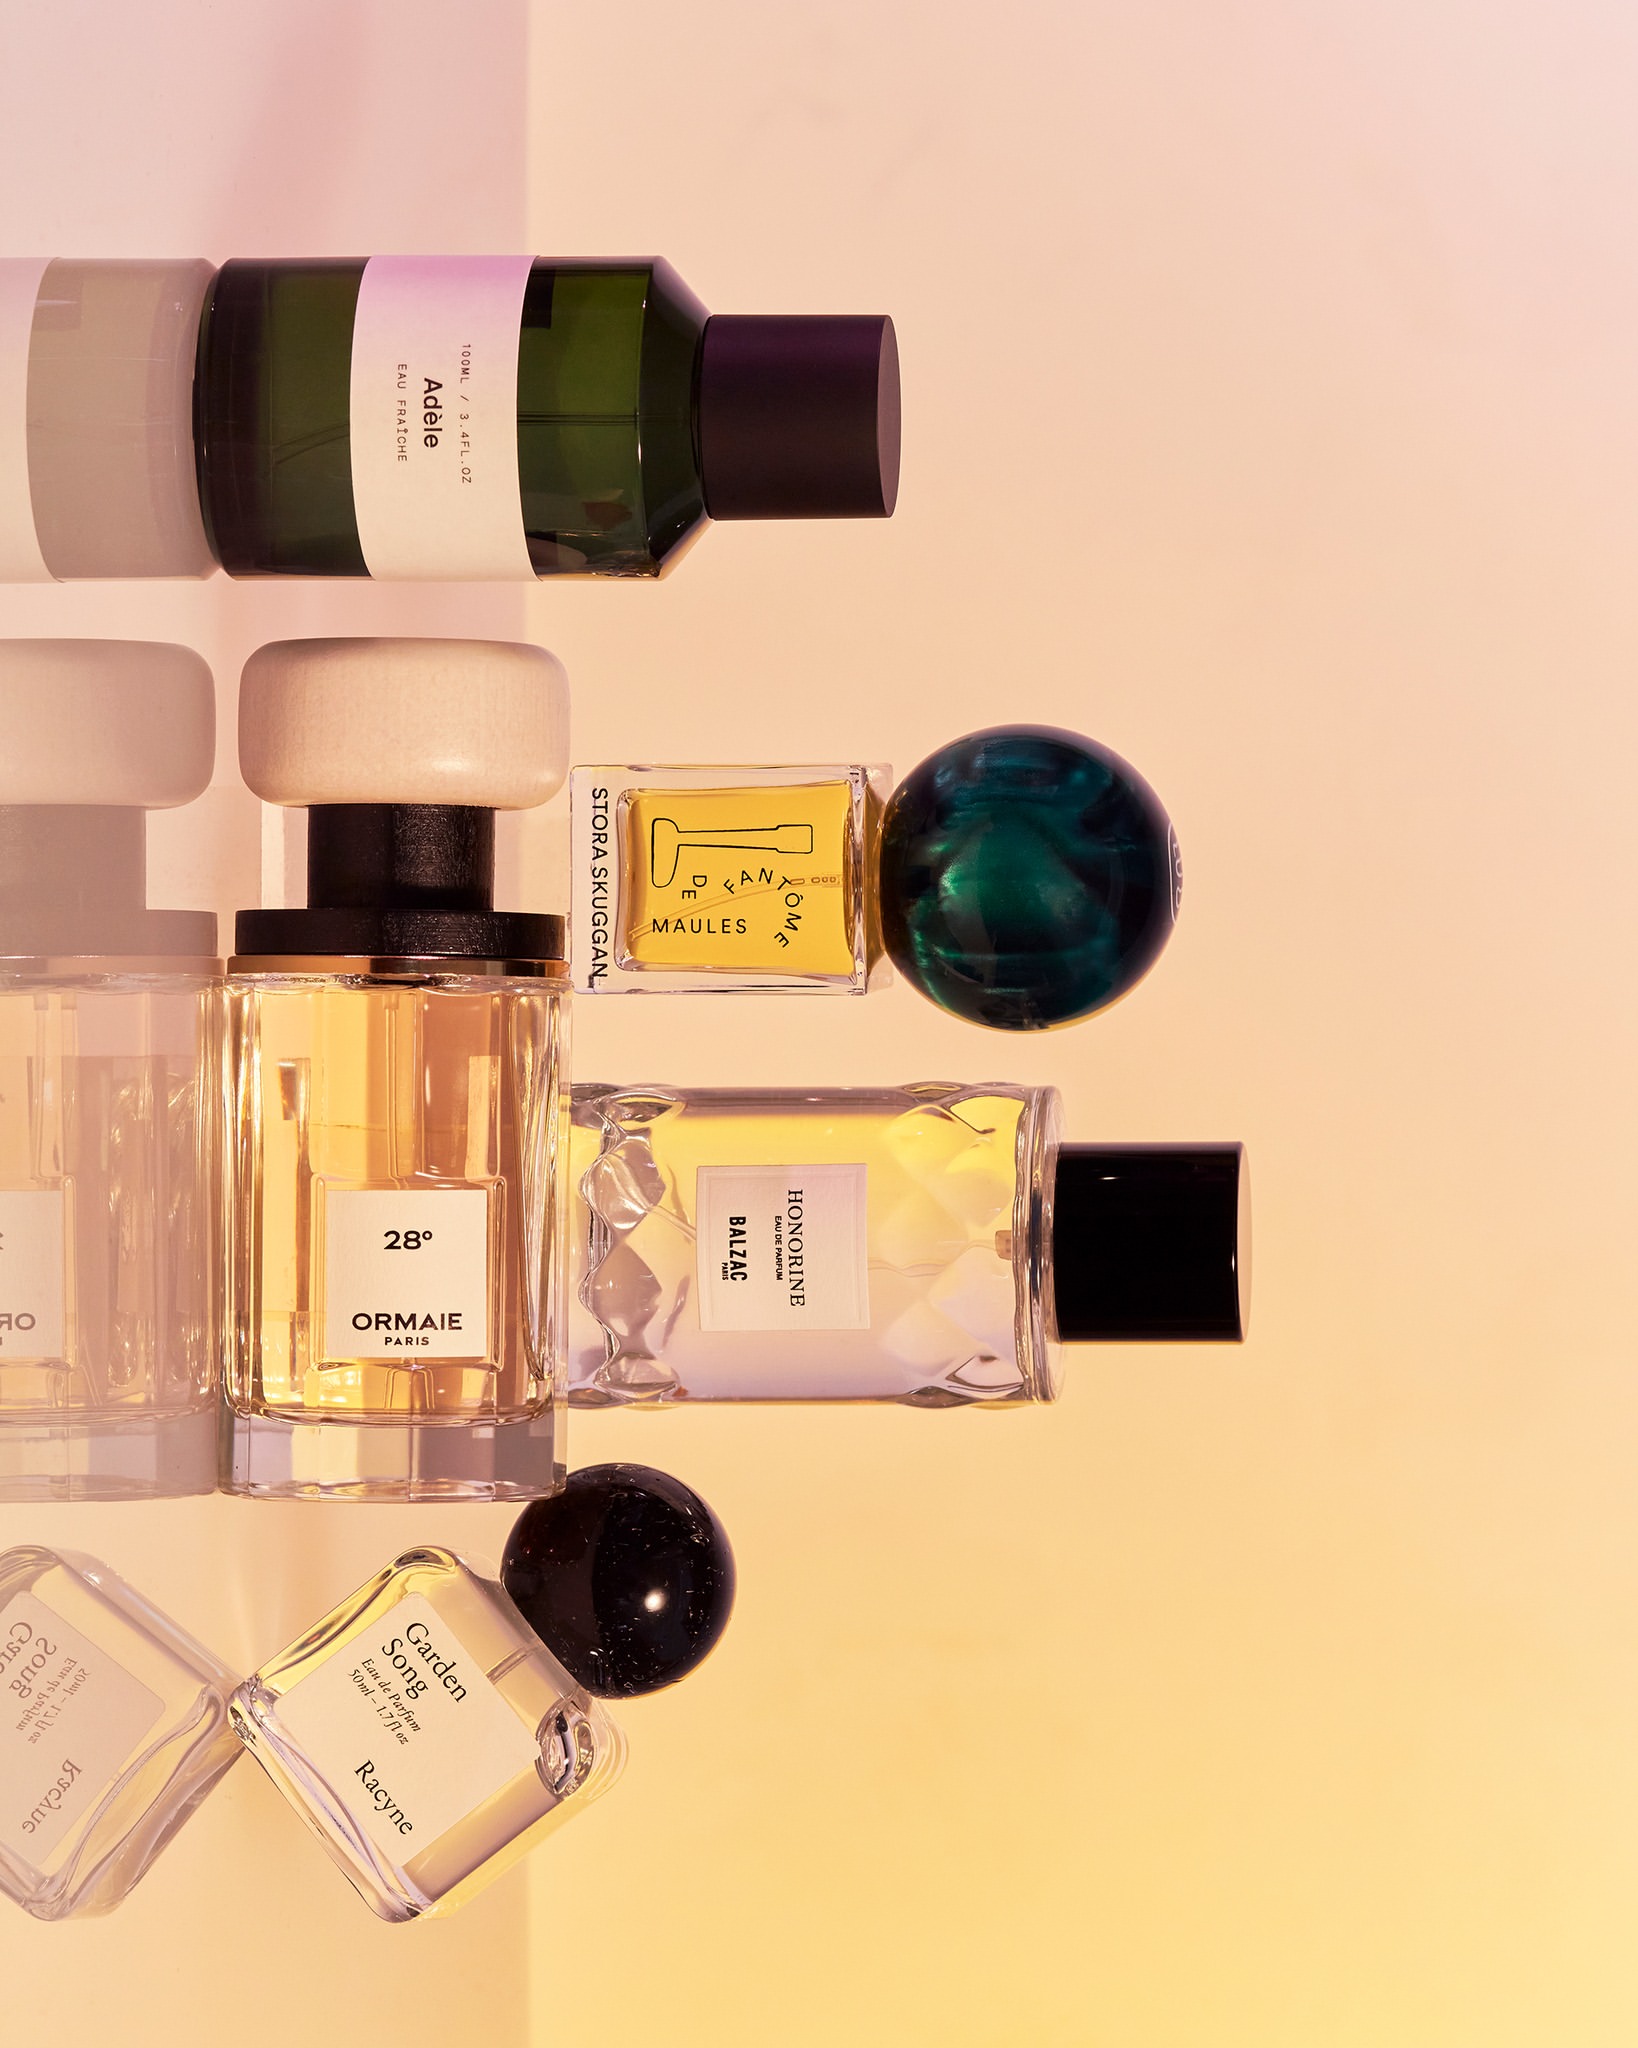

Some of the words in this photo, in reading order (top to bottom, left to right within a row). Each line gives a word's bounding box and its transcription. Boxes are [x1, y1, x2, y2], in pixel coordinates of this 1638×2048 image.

[397, 363, 408, 389] EAU
[460, 344, 471, 384] 100ML
[423, 377, 443, 448] Adèle
[397, 400, 408, 462] FRAÎCHE
[591, 787, 609, 861] STORA
[681, 875, 708, 900] DE
[591, 866, 609, 978] SKUGGAN
[723, 867, 804, 948] FANTÔME
[652, 918, 748, 935] MAULES
[774, 1215, 783, 1233] EAU
[774, 1234, 783, 1246] DE
[728, 1216, 748, 1282] BALZAC
[775, 1247, 784, 1281] PARFUM
[787, 1189, 806, 1307] HONORINE
[721, 1262, 729, 1281] PARIS
[351, 1312, 463, 1331] ORMAIE
[384, 1336, 430, 1346] PARIS
[381, 1638, 429, 1700] Song
[406, 1622, 468, 1703] Garden
[347, 1668, 376, 1697] 50ml
[361, 1658, 381, 1681] Eau
[377, 1680, 392, 1694] de
[388, 1693, 421, 1732] Parfum
[376, 1705, 395, 1720] 1.7
[383, 1720, 403, 1732] fl
[395, 1732, 409, 1745] oz
[353, 1759, 414, 1835] Racyne
